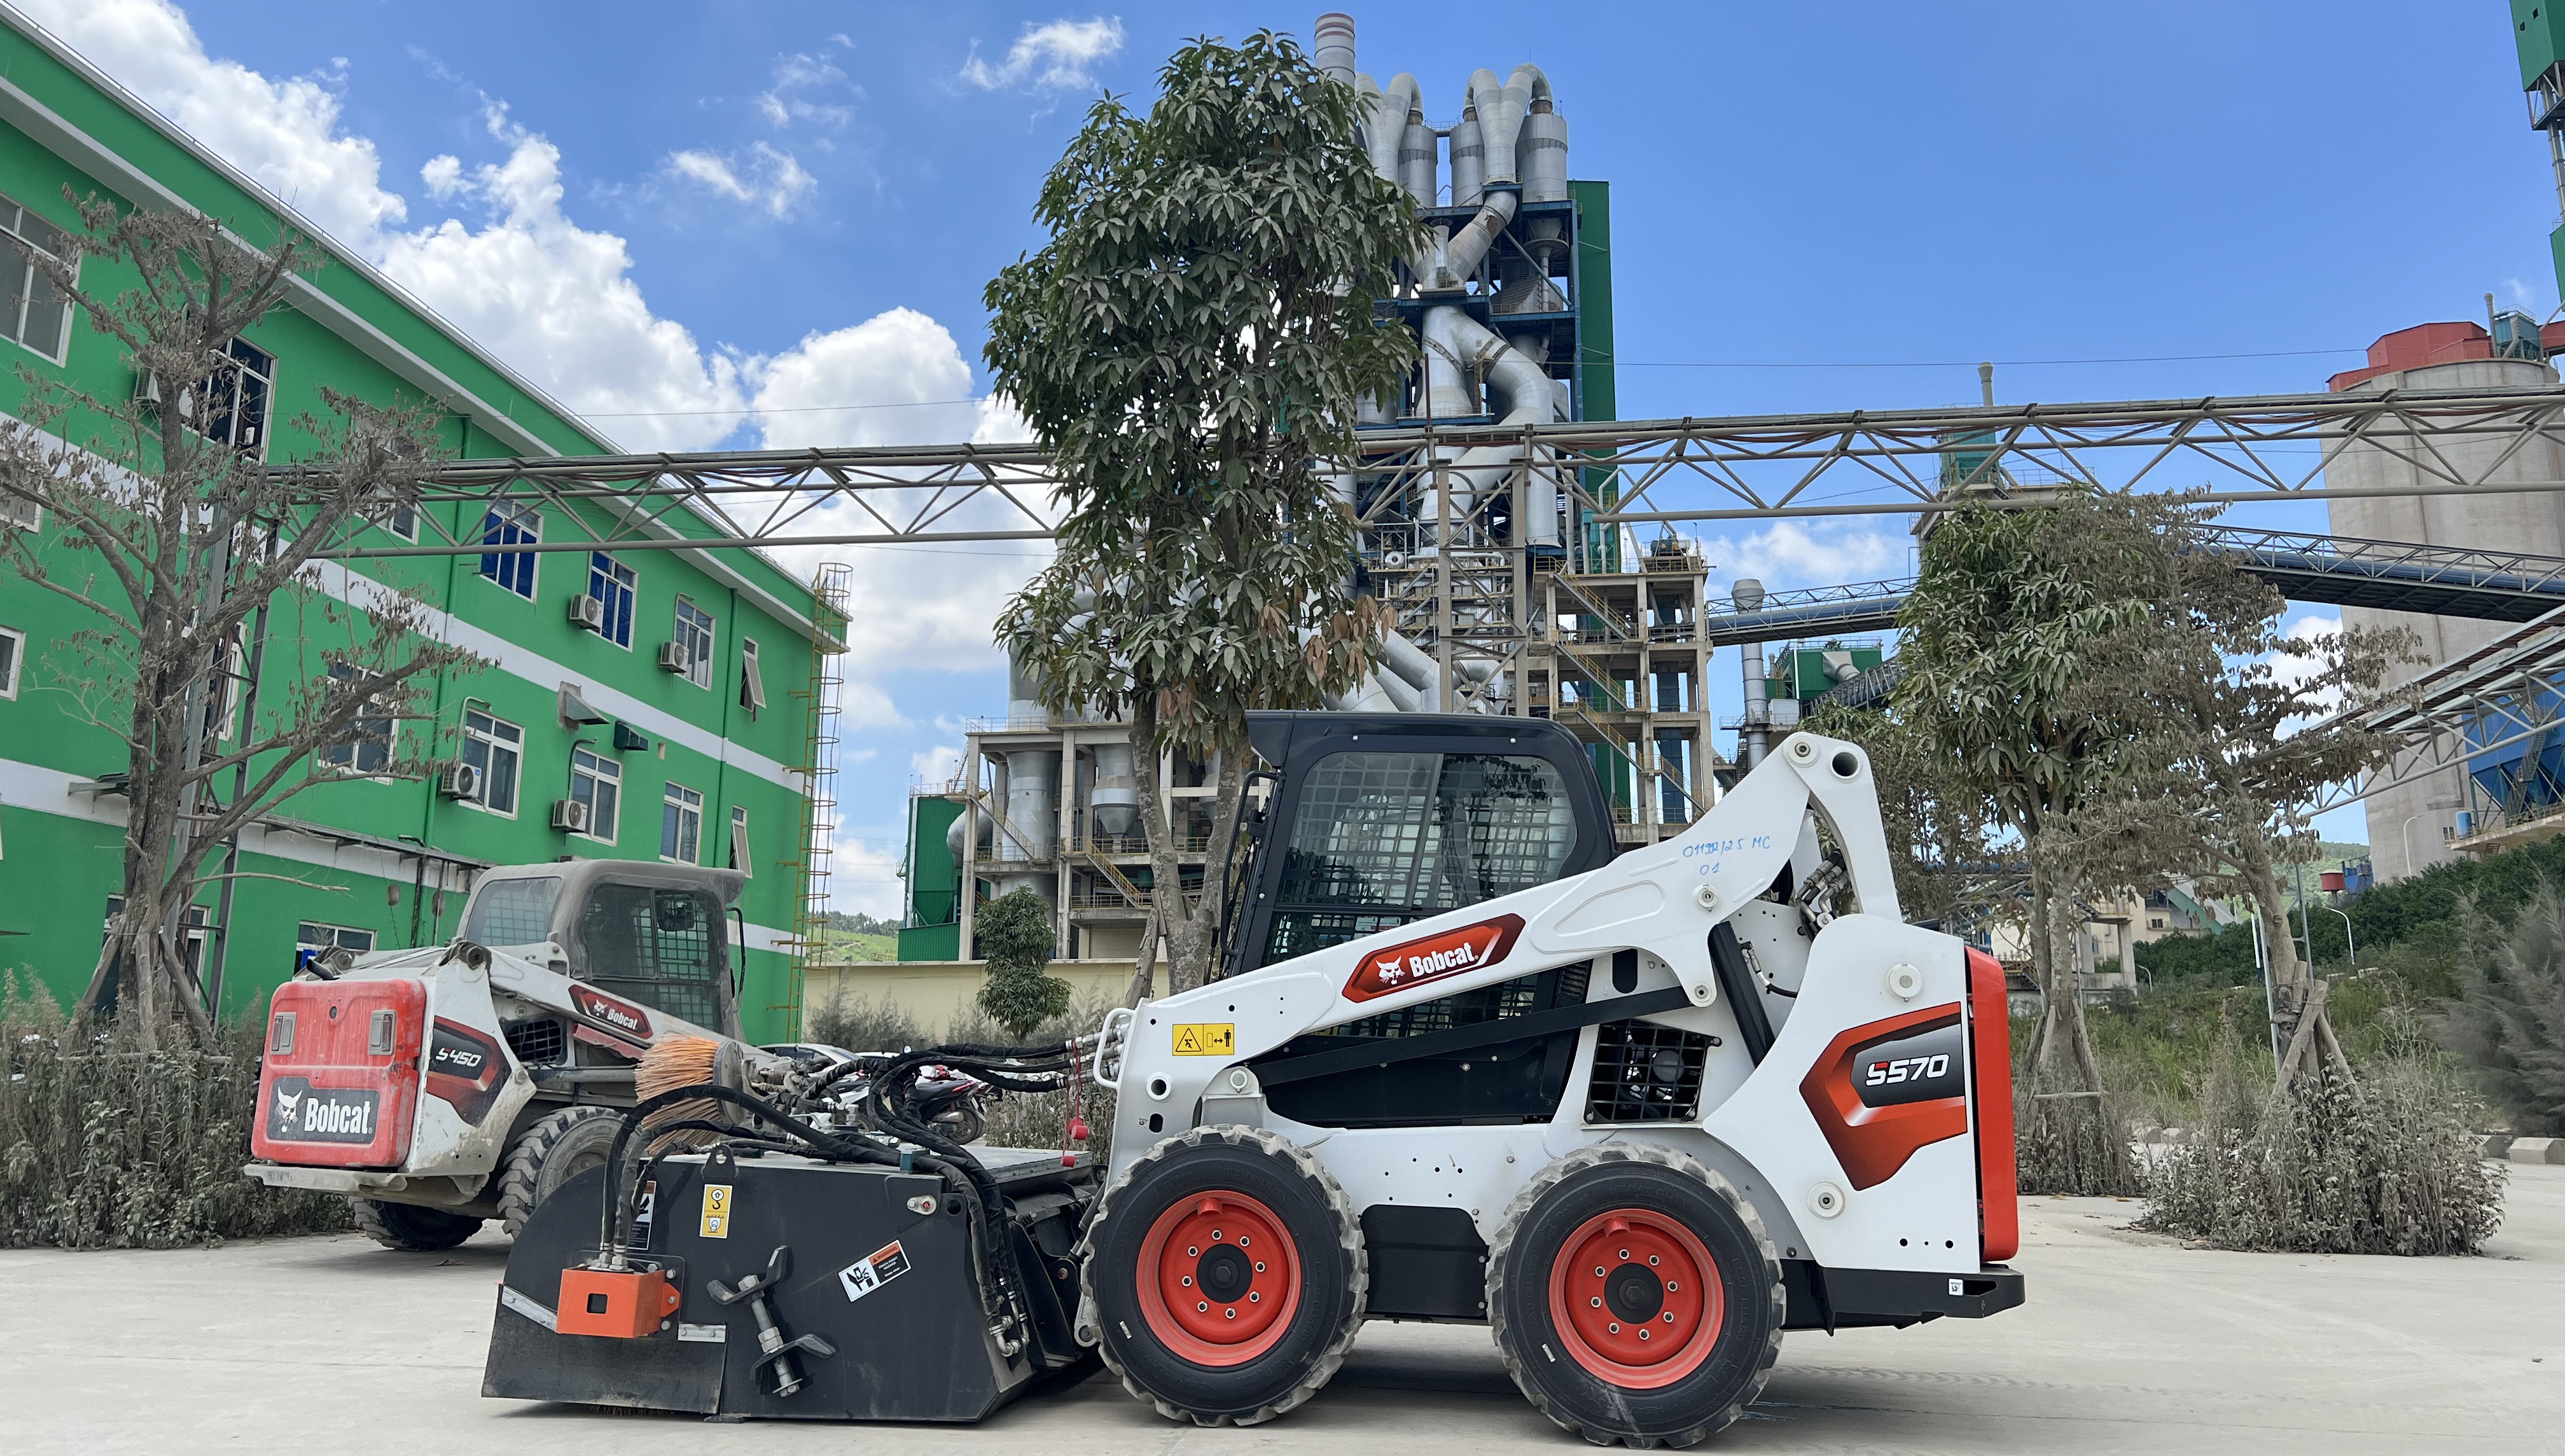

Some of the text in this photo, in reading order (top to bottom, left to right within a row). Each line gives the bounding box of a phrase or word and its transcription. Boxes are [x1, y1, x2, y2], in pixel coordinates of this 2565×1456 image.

[1752, 835, 1771, 849] MC
[1699, 863, 1720, 876] 01
[1408, 942, 1475, 978] Bobcat
[606, 1008, 637, 1030] Bobcat
[435, 1047, 482, 1067] S450
[1865, 1052, 1950, 1086] S570
[304, 1097, 370, 1135] Bobcat
